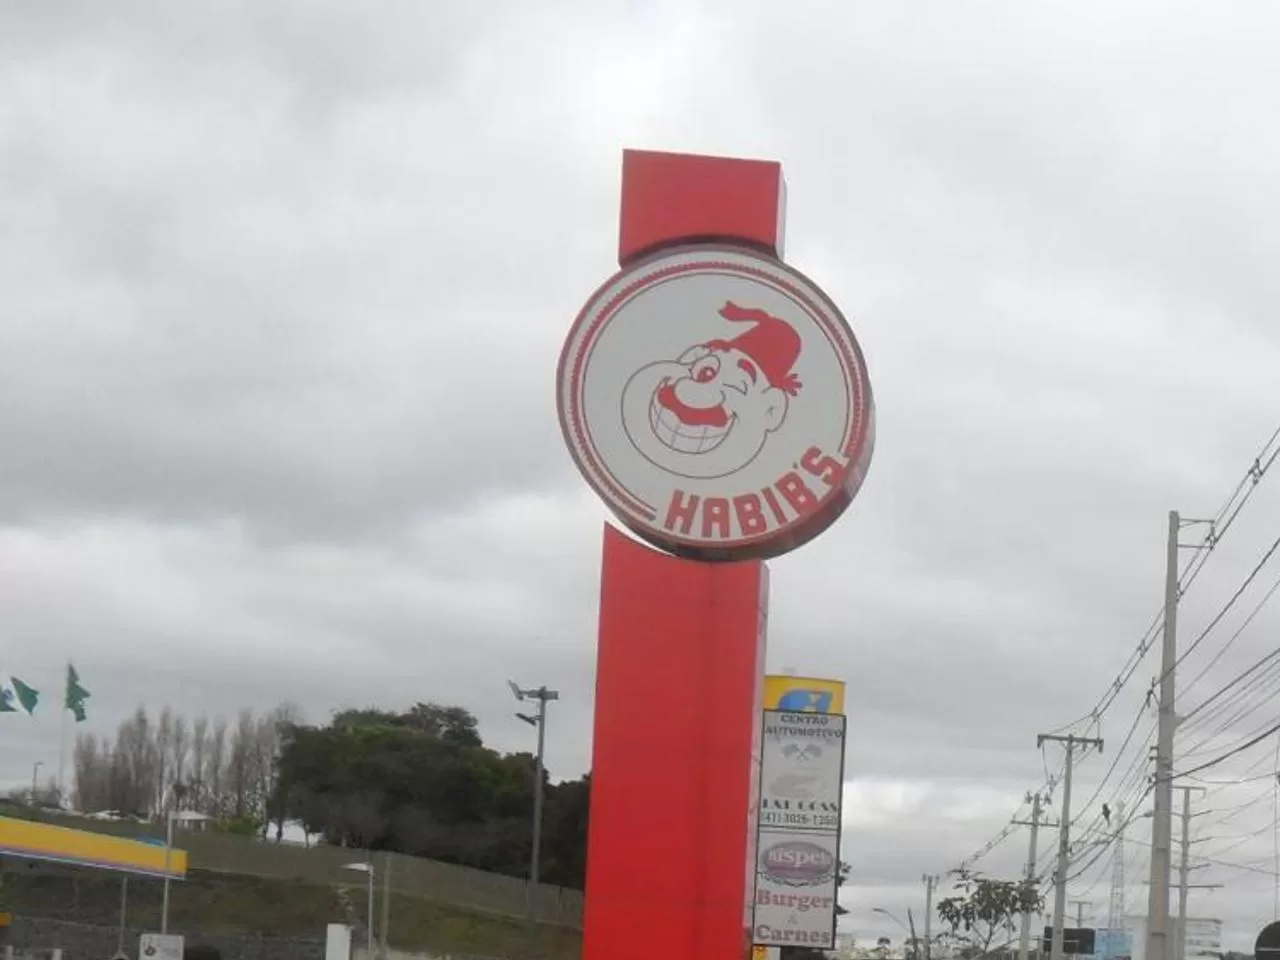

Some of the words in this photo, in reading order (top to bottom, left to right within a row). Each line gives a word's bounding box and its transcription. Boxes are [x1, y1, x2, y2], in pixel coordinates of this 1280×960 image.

[664, 445, 847, 539] HABIB'S
[780, 713, 829, 725] CENTRO
[757, 889, 832, 912] Burger
[755, 924, 830, 943] Carnes
